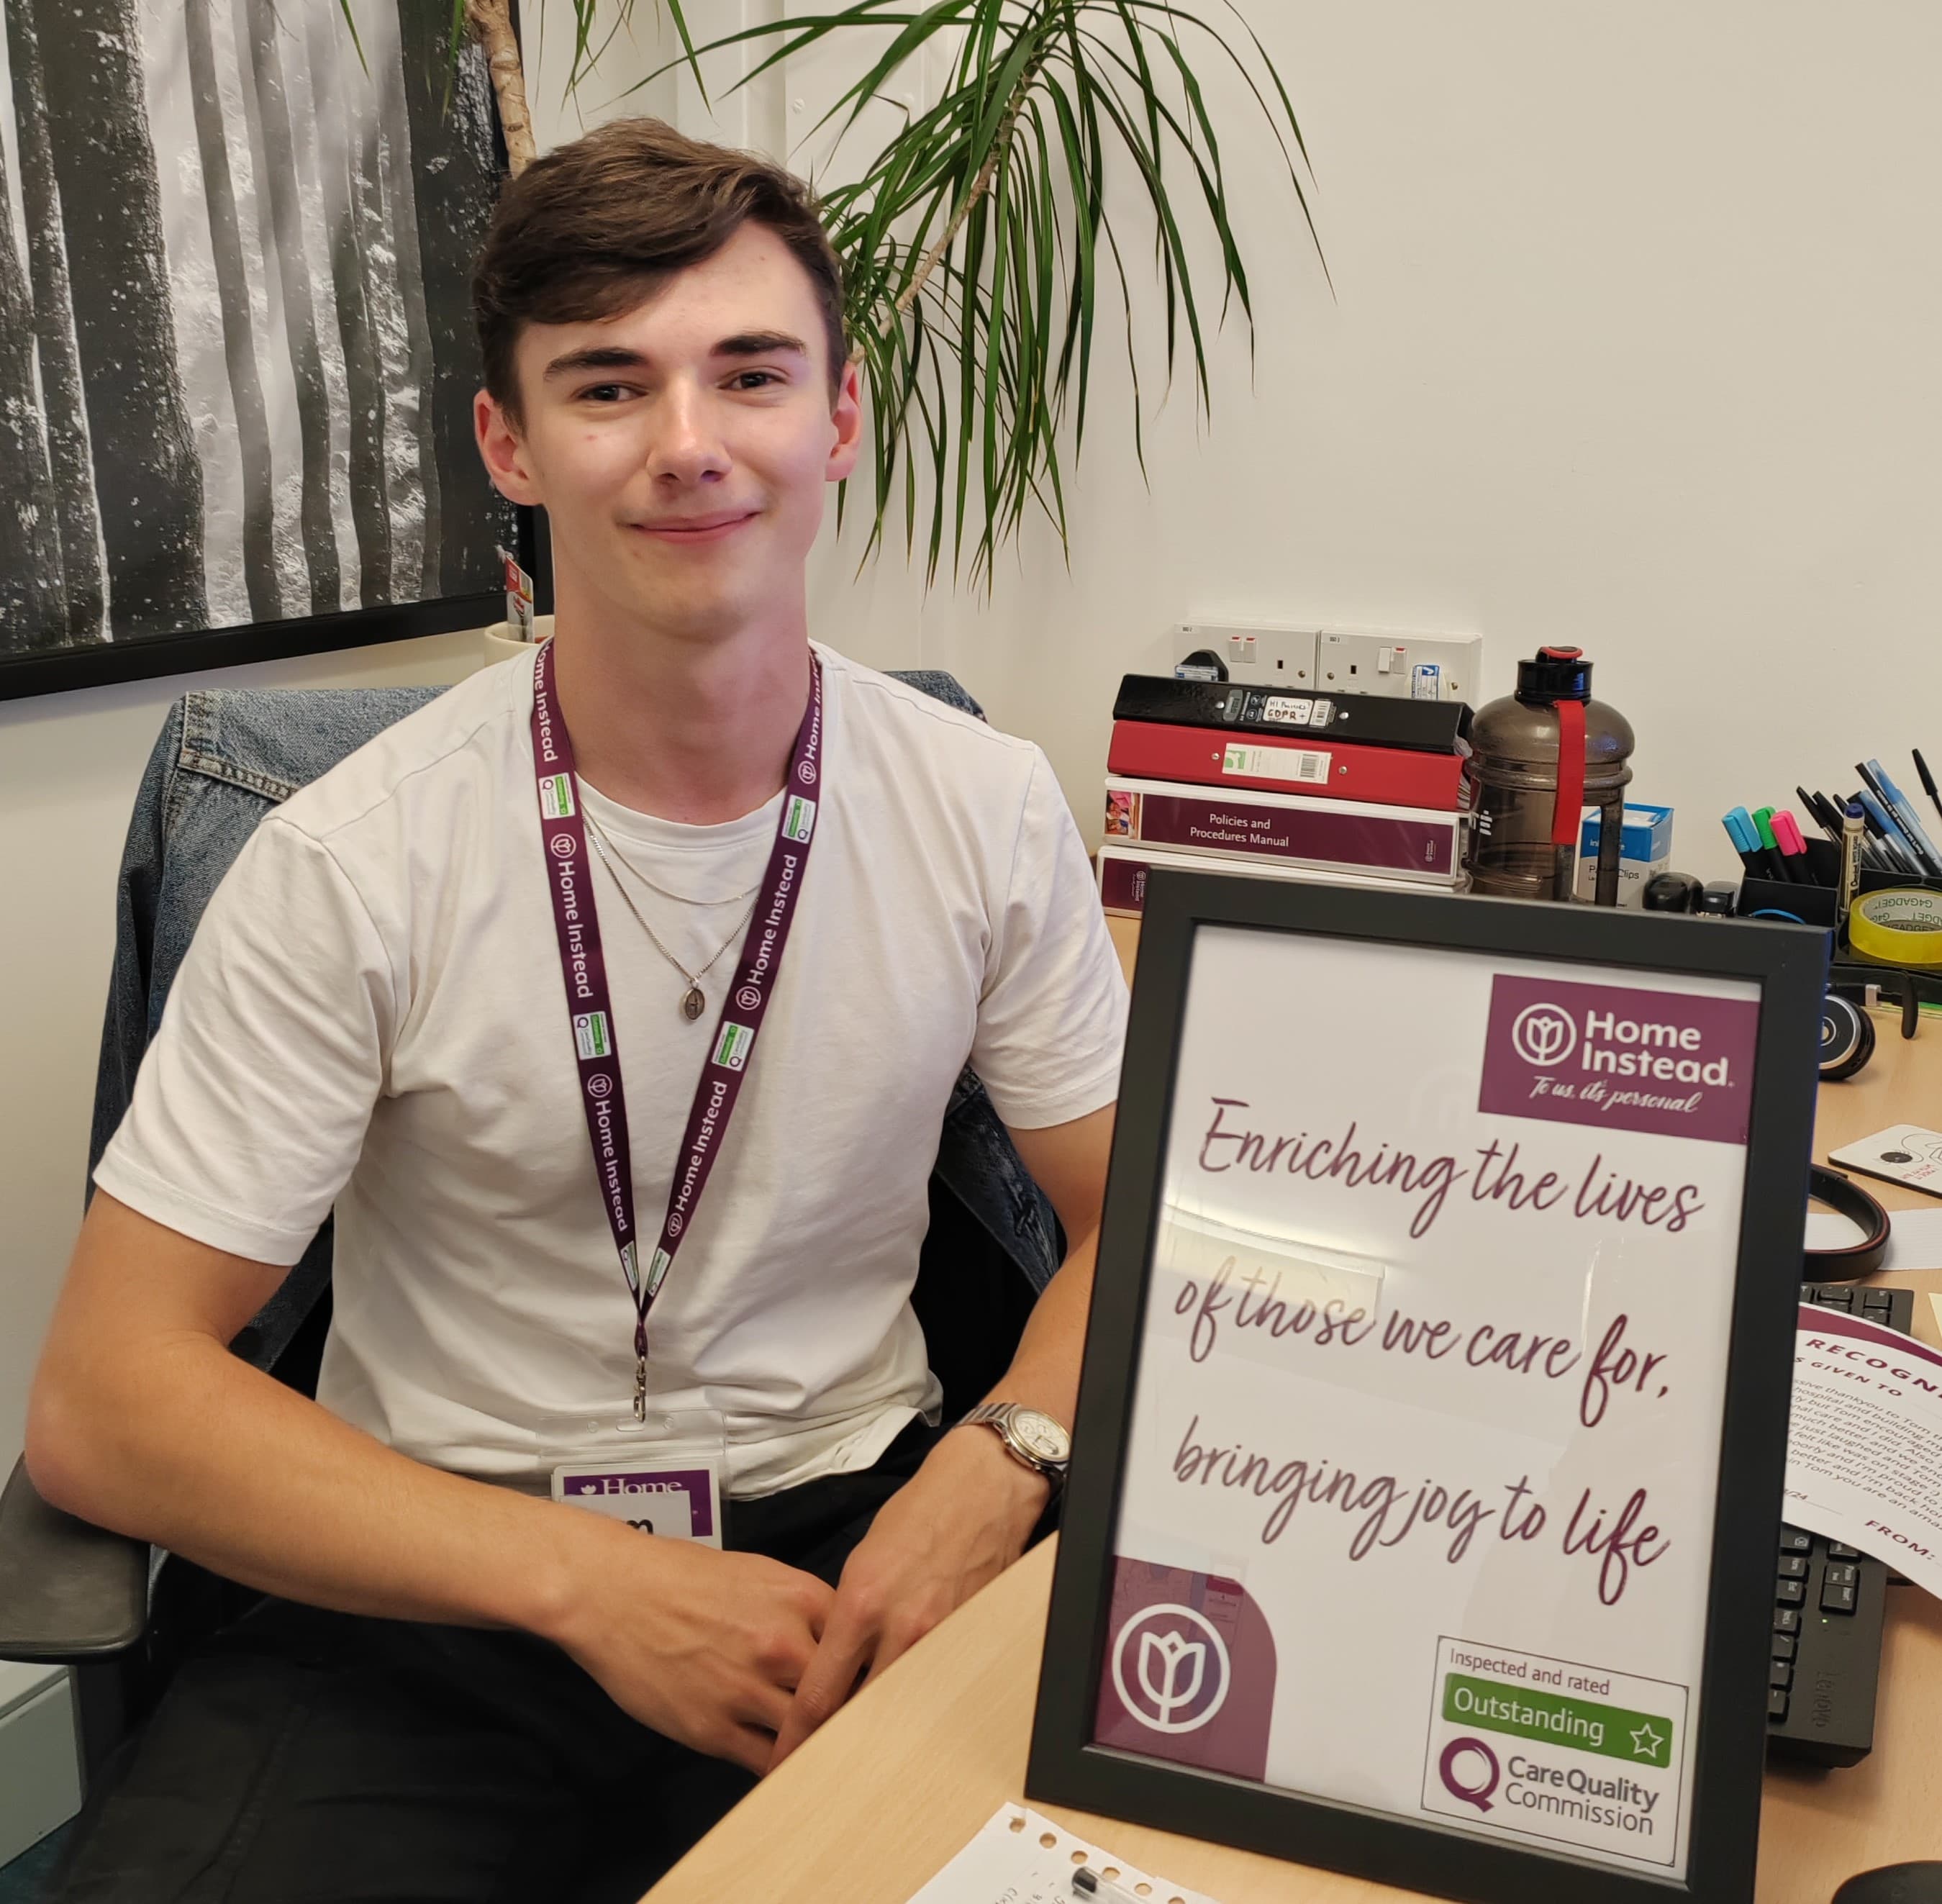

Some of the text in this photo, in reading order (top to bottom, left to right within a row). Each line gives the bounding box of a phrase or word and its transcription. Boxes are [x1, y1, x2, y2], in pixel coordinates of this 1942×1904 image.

[535, 692, 558, 762] Instead
[804, 706, 821, 760] Home
[1268, 710, 1297, 720] GDPR
[1190, 827, 1289, 846] Procedures Manual
[1210, 813, 1271, 829] Policies and
[558, 861, 579, 921] Home
[1877, 897, 1933, 908] G4GADGET
[747, 854, 798, 985] Home Instead
[568, 923, 594, 998] Instead
[1584, 1010, 1701, 1051] Home
[1582, 1042, 1728, 1087] Instead
[1530, 1076, 1553, 1099] To
[1601, 1092, 1702, 1113] personal
[596, 1100, 628, 1232] Home Instead
[675, 1081, 727, 1212] Home Instead
[1199, 1097, 1705, 1238] Enriching the lives
[1175, 1256, 1670, 1428] of those we care for,
[1810, 1361, 1871, 1384] GIVEN
[1877, 1383, 1902, 1396] TO
[1807, 1400, 1831, 1409] but
[1833, 1406, 1861, 1420] Tom
[1863, 1419, 1941, 1457] encouraged
[1813, 1410, 1842, 1422] care
[1843, 1421, 1871, 1432] and
[1905, 1449, 1934, 1464] Also
[1825, 1387, 1884, 1411] thankyou
[1903, 1418, 1930, 1434] Tom
[1844, 1405, 1871, 1415] and
[1871, 1413, 1925, 1441] building
[1818, 1438, 1841, 1449] like
[1843, 1448, 1869, 1461] was
[1871, 1460, 1889, 1469] on
[1892, 1469, 1928, 1490] stage
[1828, 1423, 1869, 1440] better
[1869, 1441, 1898, 1454] and
[1900, 1453, 1918, 1464] we
[1828, 1433, 1882, 1456] laughed
[1882, 1456, 1911, 1469] and
[1912, 1470, 1941, 1487] Tom
[601, 1477, 683, 1495] Home
[1791, 1449, 1833, 1464] better
[1832, 1464, 1861, 1476] and
[1885, 1485, 1918, 1504] back
[1805, 1462, 1833, 1476] Tom
[1832, 1474, 1861, 1487] you
[1862, 1487, 1887, 1498] are
[1888, 1499, 1907, 1509] an
[1826, 1452, 1854, 1464] and
[1877, 1473, 1923, 1496] proud
[1923, 1495, 1938, 1505] to
[1173, 1415, 1671, 1605] bringing joy to life
[1864, 1520, 1936, 1561] FROM:
[1451, 1648, 1610, 1695] Inspected and rated
[1454, 1687, 1605, 1746] Outstanding
[1505, 1782, 1653, 1835] Commission
